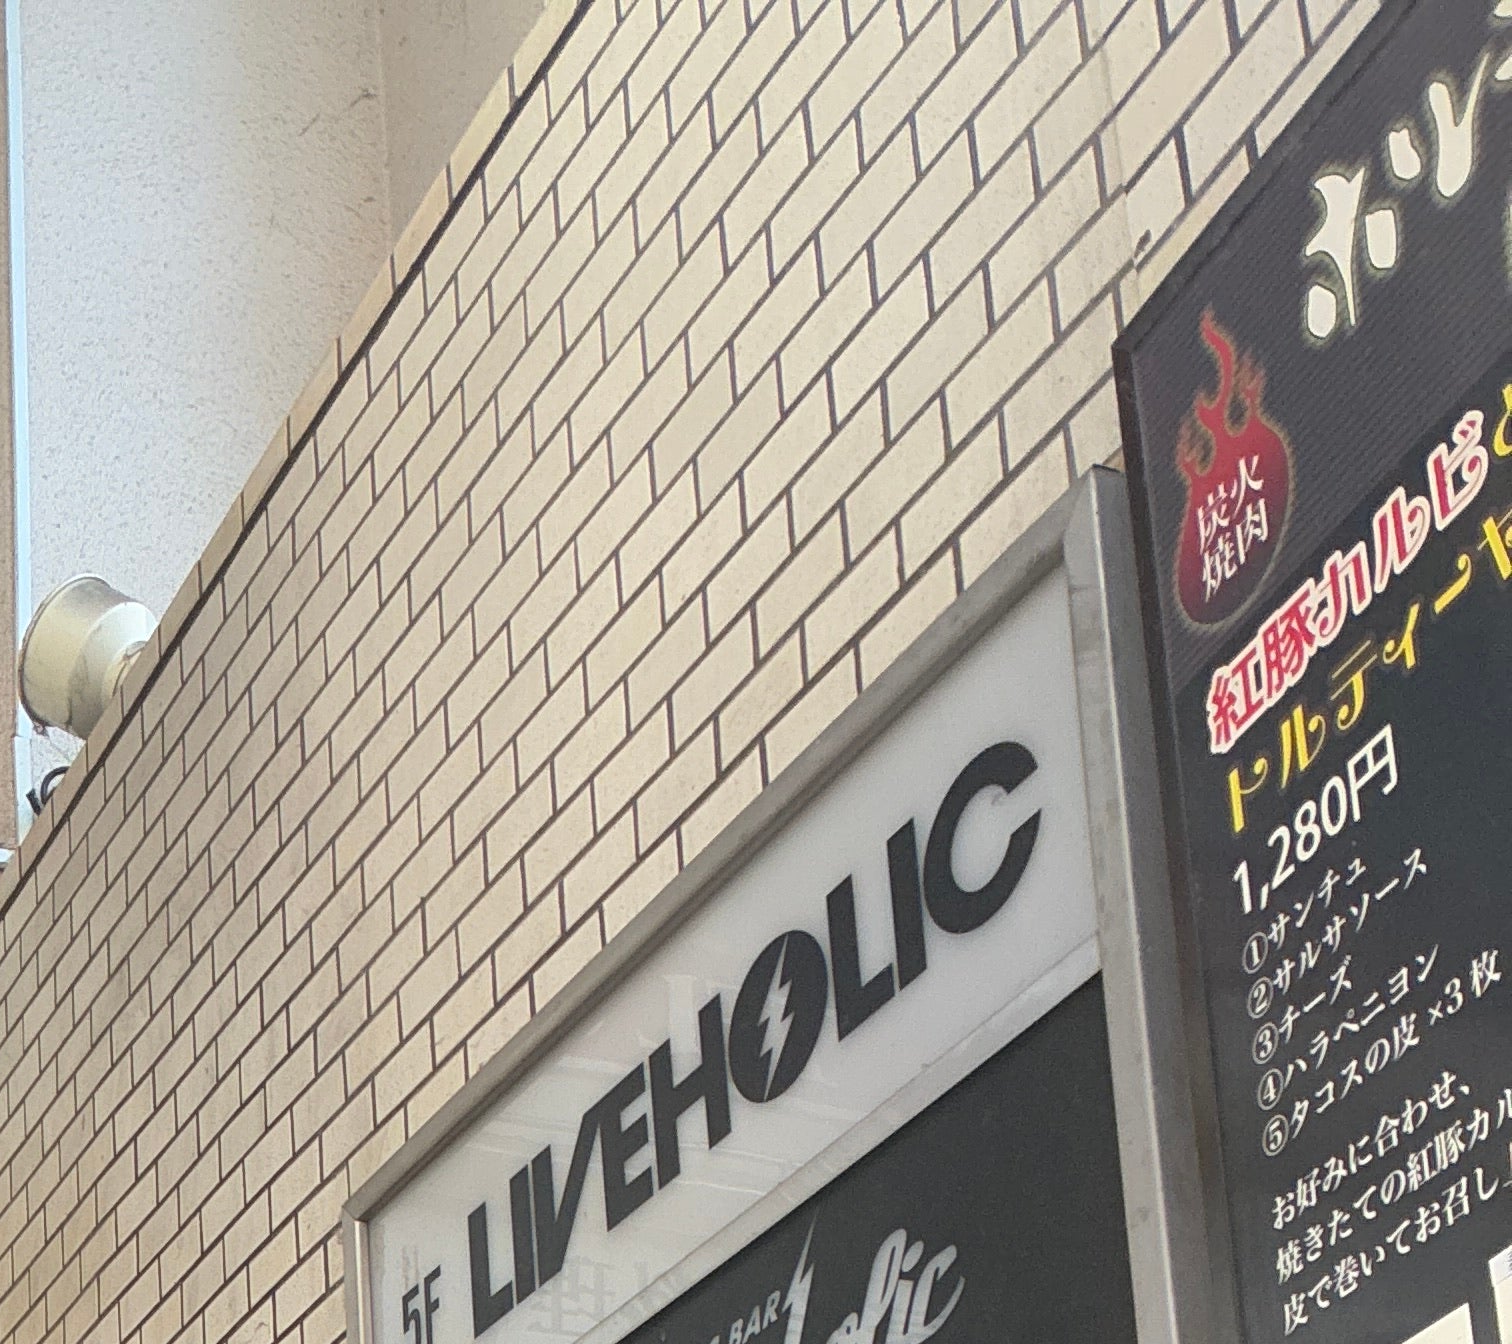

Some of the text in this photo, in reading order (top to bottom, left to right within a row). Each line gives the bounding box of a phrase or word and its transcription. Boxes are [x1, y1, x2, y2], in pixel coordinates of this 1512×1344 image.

[1304, 0, 1512, 338] ホル
[1206, 384, 1512, 753] 紅豚カルビ
[1232, 725, 1398, 915] 1,280円
[467, 741, 1042, 1339] LIVEHOLIC
[1284, 1167, 1512, 1336] 皮で巻いてお召し
